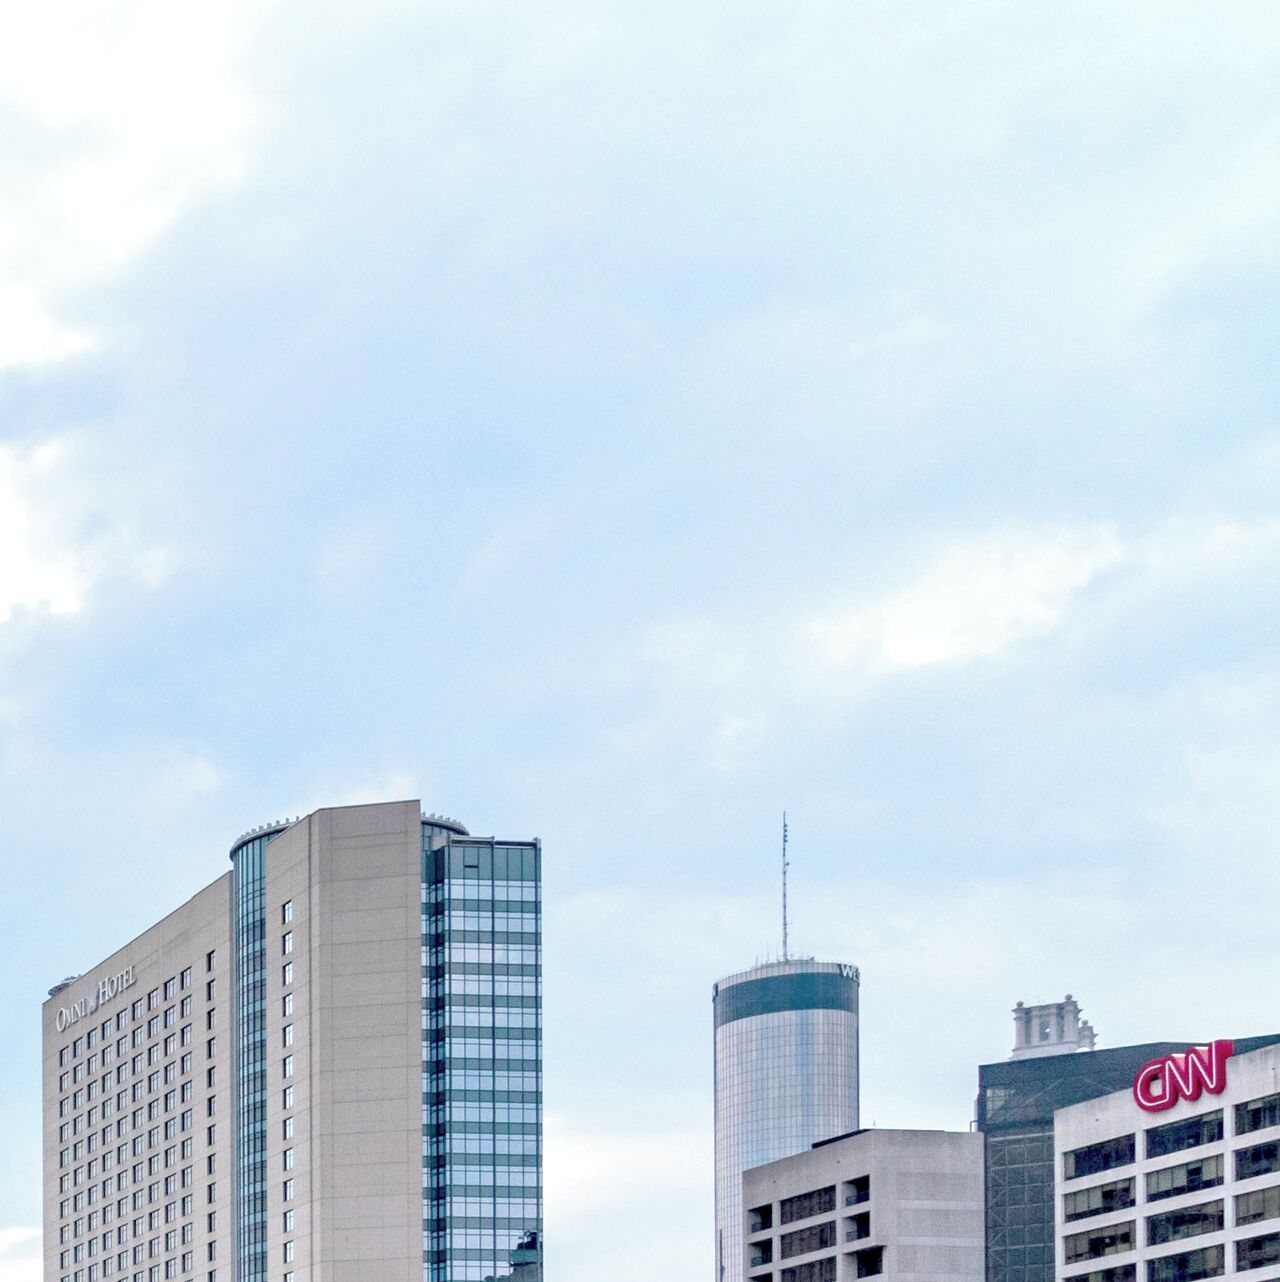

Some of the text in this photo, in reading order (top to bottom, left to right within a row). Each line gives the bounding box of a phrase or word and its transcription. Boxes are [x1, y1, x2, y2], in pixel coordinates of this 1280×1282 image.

[56, 966, 137, 1032] OMNI HOTEL
[840, 963, 860, 981] WE
[1133, 1039, 1233, 1112] CNN
